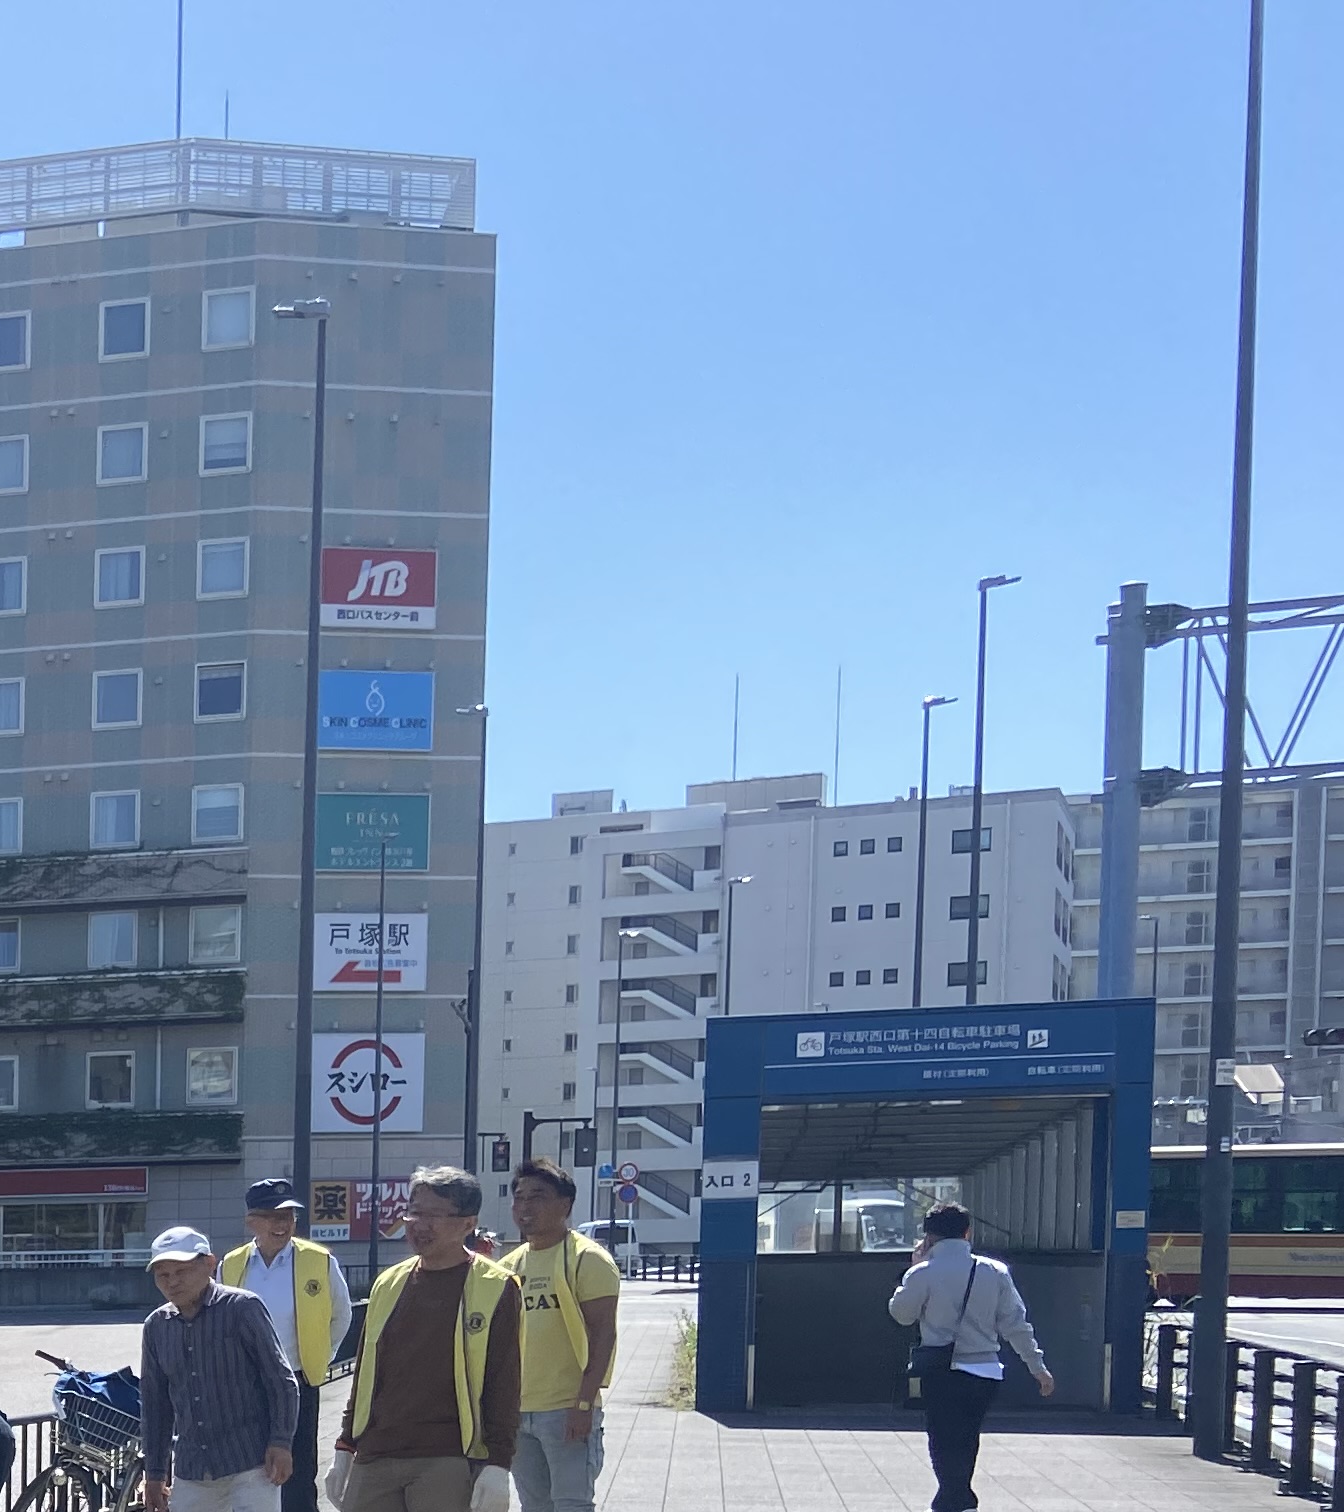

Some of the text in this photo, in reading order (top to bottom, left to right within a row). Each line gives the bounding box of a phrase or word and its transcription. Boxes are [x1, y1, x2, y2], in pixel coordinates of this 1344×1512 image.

[347, 559, 409, 602] JTB
[322, 716, 427, 729] SKIN COSME CLINIC
[329, 923, 409, 947] 戸塚駅
[829, 1046, 864, 1056] Totsuka
[888, 1043, 912, 1053] West
[947, 1040, 980, 1052] Bicycle
[983, 1039, 1019, 1050] Parking
[325, 1071, 407, 1094] スシロー
[705, 1173, 751, 1189] 入口 2
[314, 1185, 347, 1220] 薬
